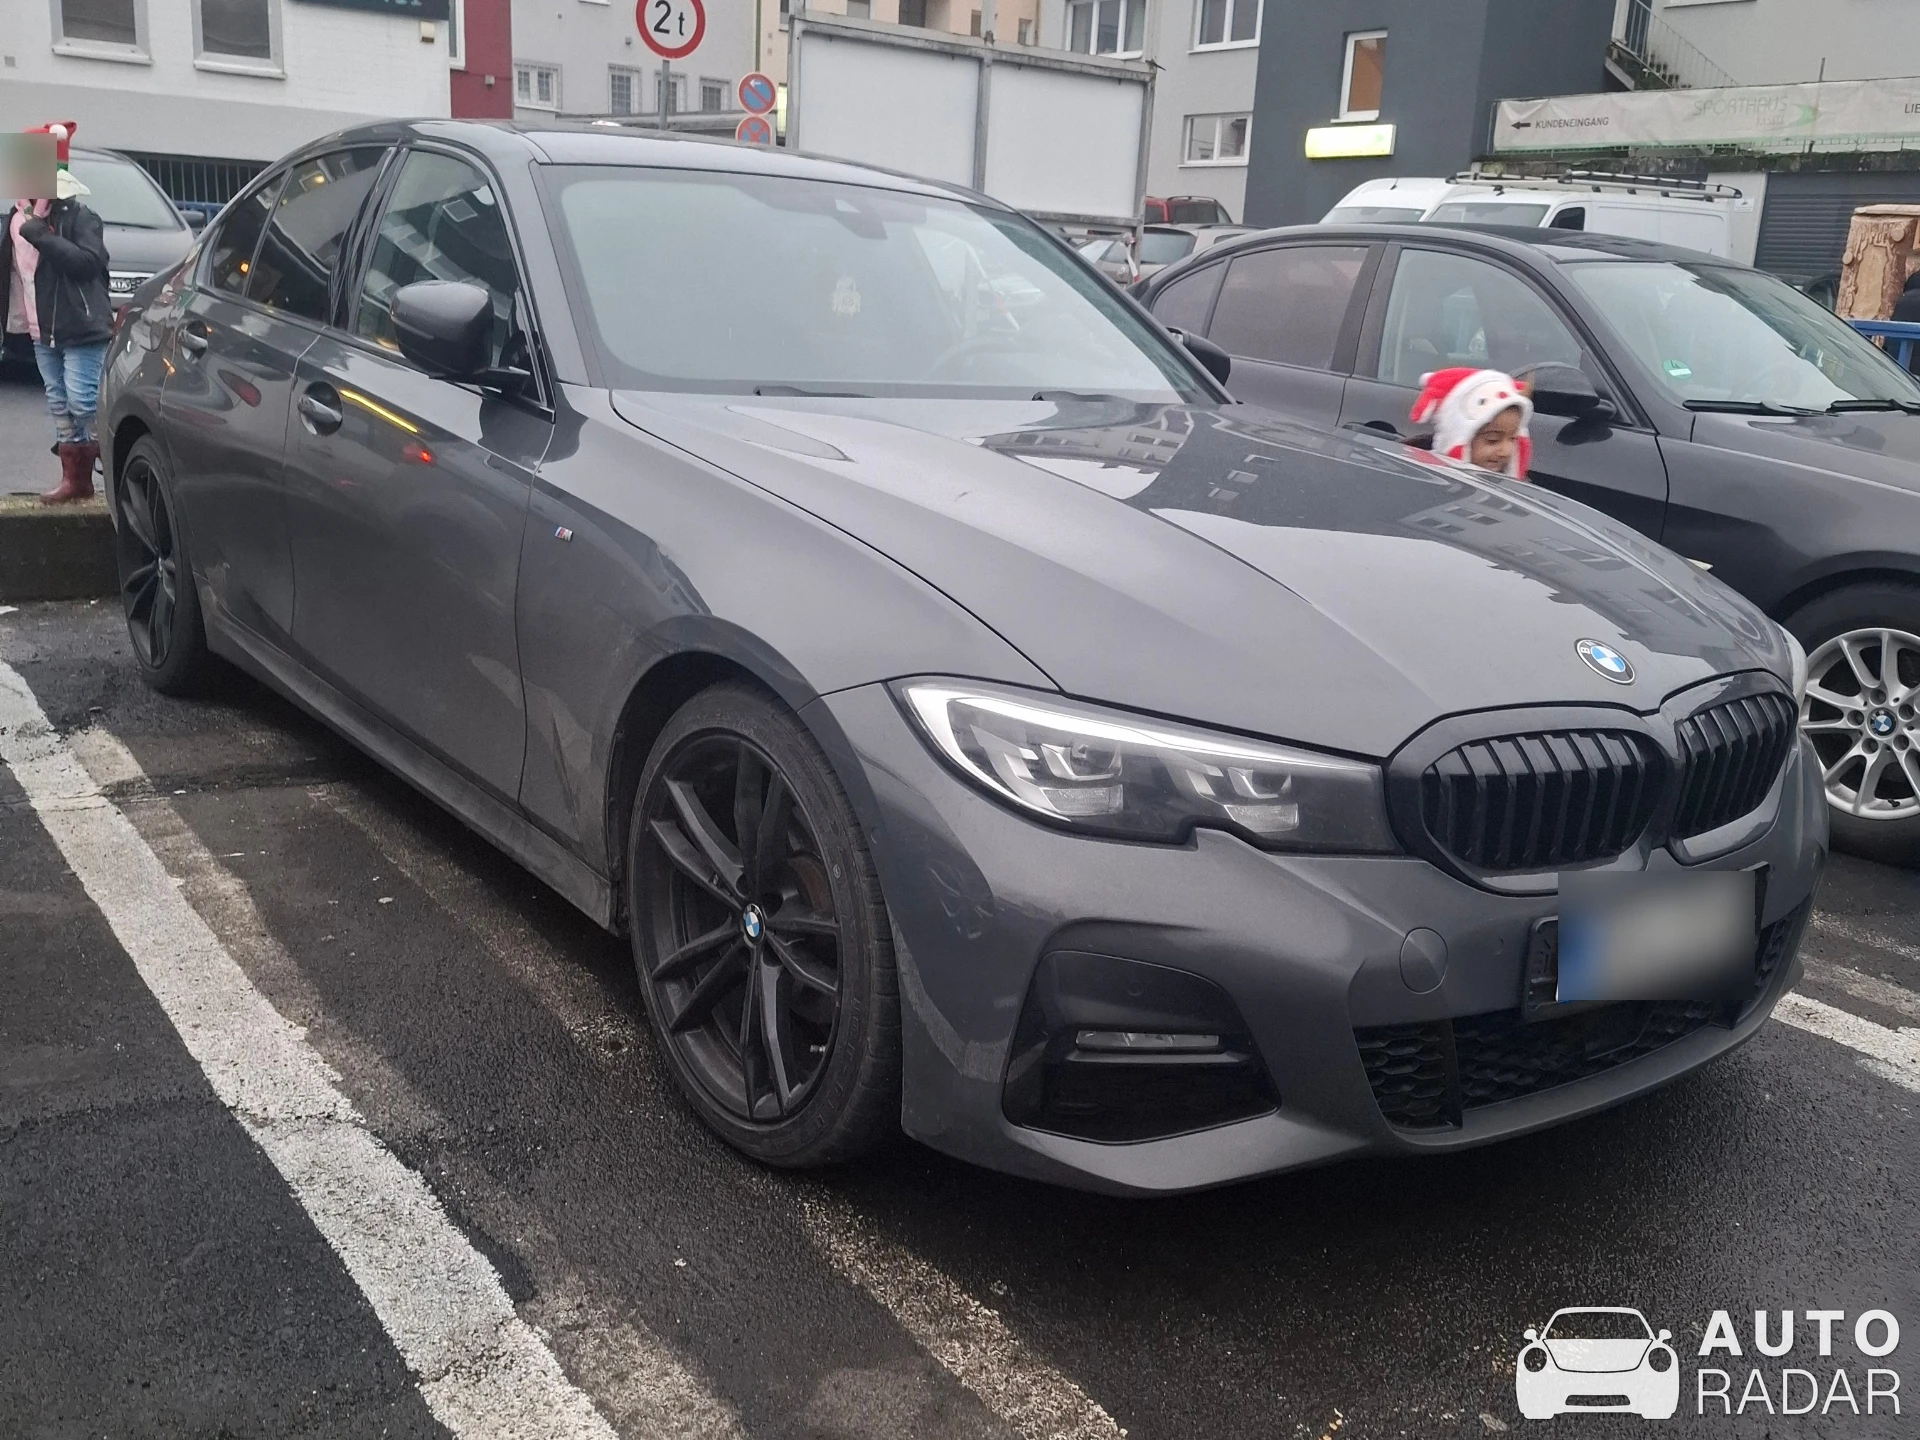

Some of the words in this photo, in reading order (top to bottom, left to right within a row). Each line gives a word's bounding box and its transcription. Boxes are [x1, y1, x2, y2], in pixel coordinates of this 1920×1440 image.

[653, 0, 671, 34] 2
[678, 12, 685, 36] t
[1693, 97, 1788, 116] SPORTHAUS
[1535, 117, 1609, 129] KUNDENEINGANG
